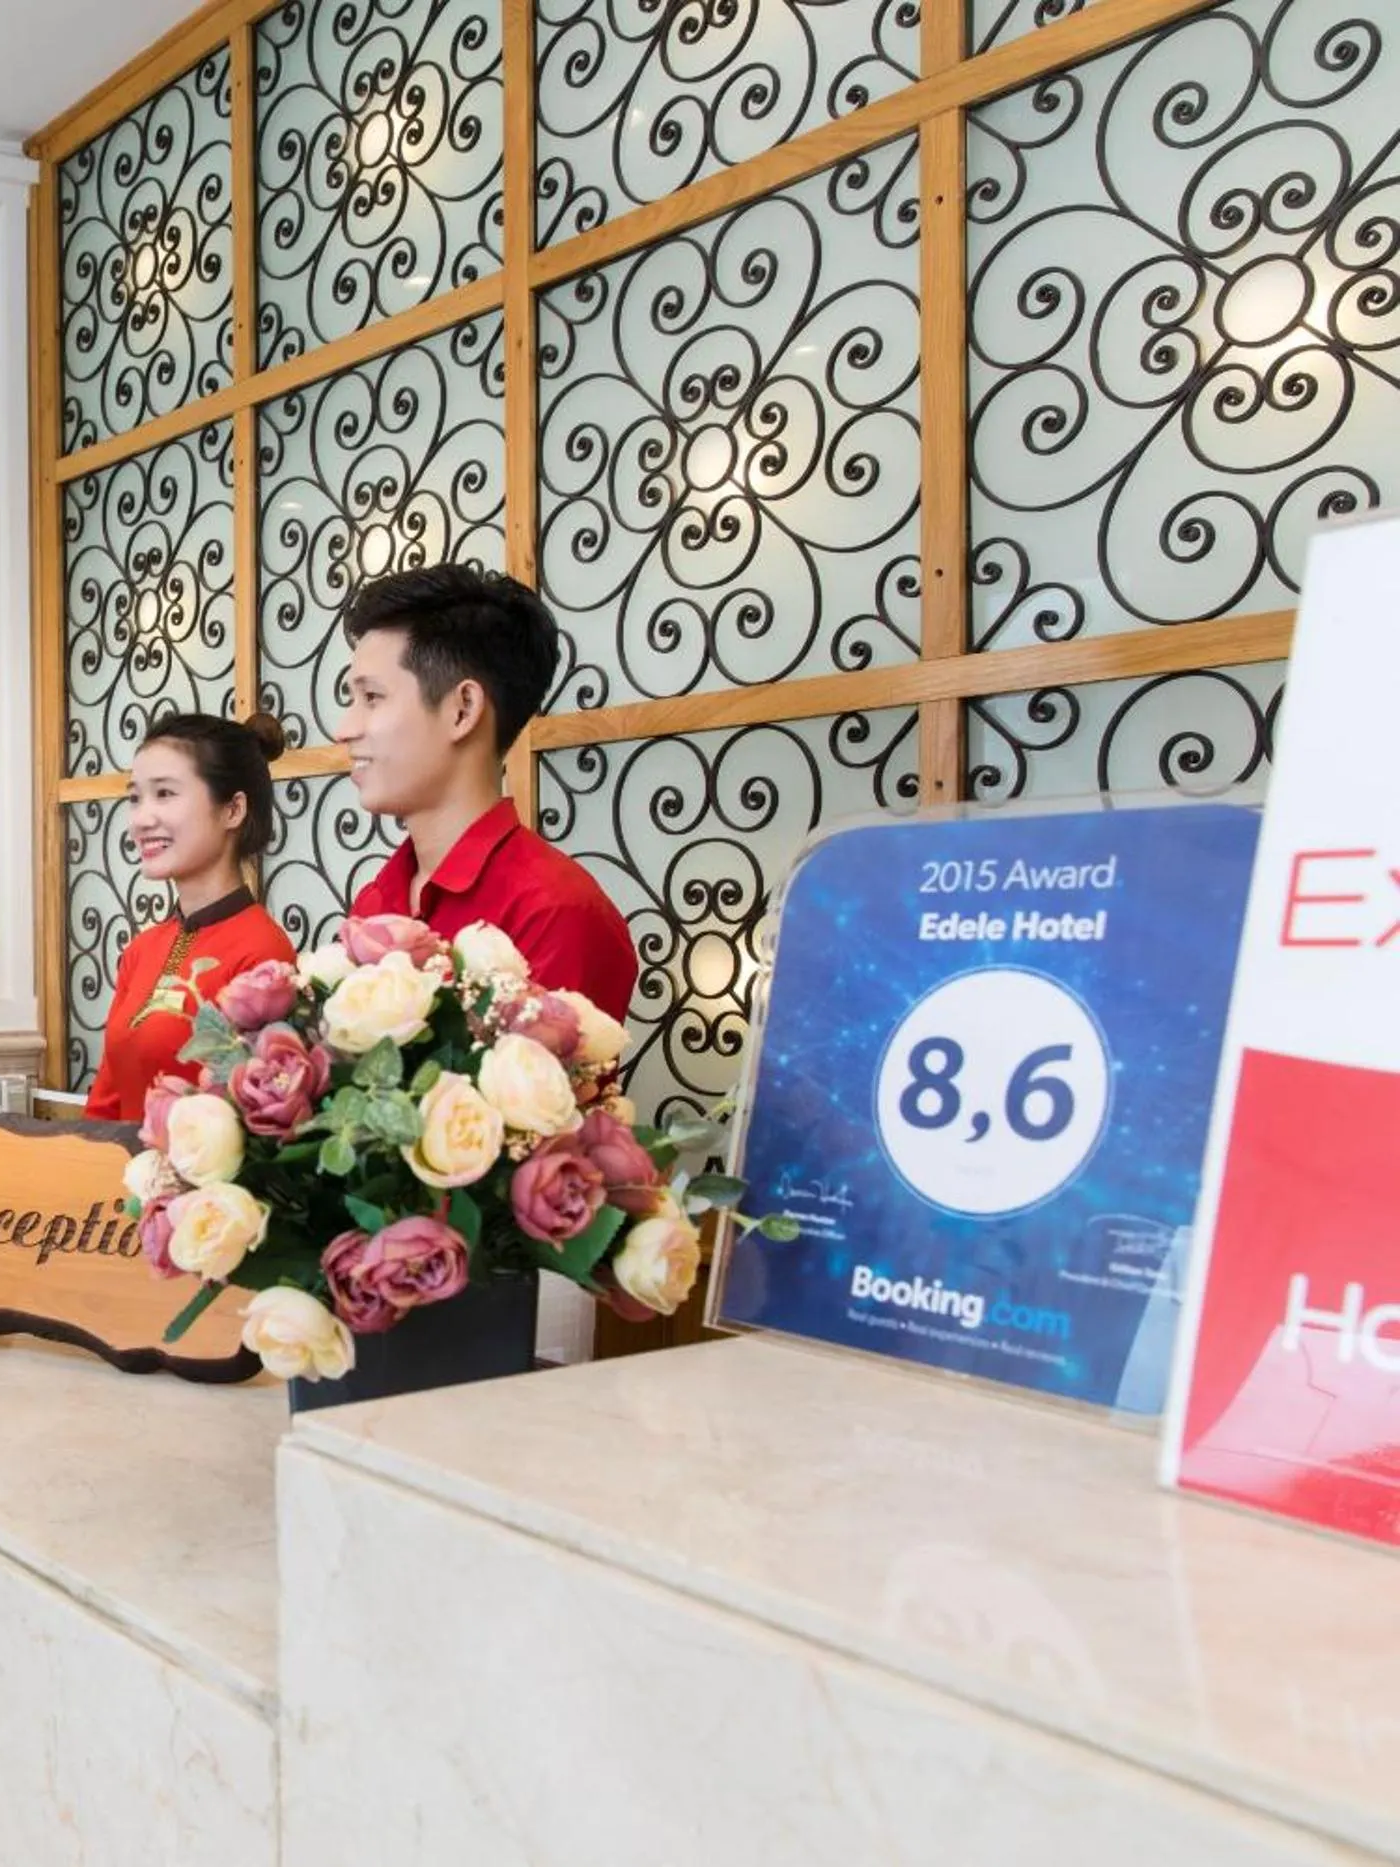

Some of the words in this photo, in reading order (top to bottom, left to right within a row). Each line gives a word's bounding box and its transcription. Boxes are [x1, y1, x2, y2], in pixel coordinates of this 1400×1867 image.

[919, 859, 998, 893] 2015
[1002, 854, 1117, 891] Award
[919, 911, 1007, 941] Edele
[1012, 909, 1108, 941] Hotel
[899, 1035, 1075, 1142] 8,6
[850, 1264, 1073, 1340] Booking.com
